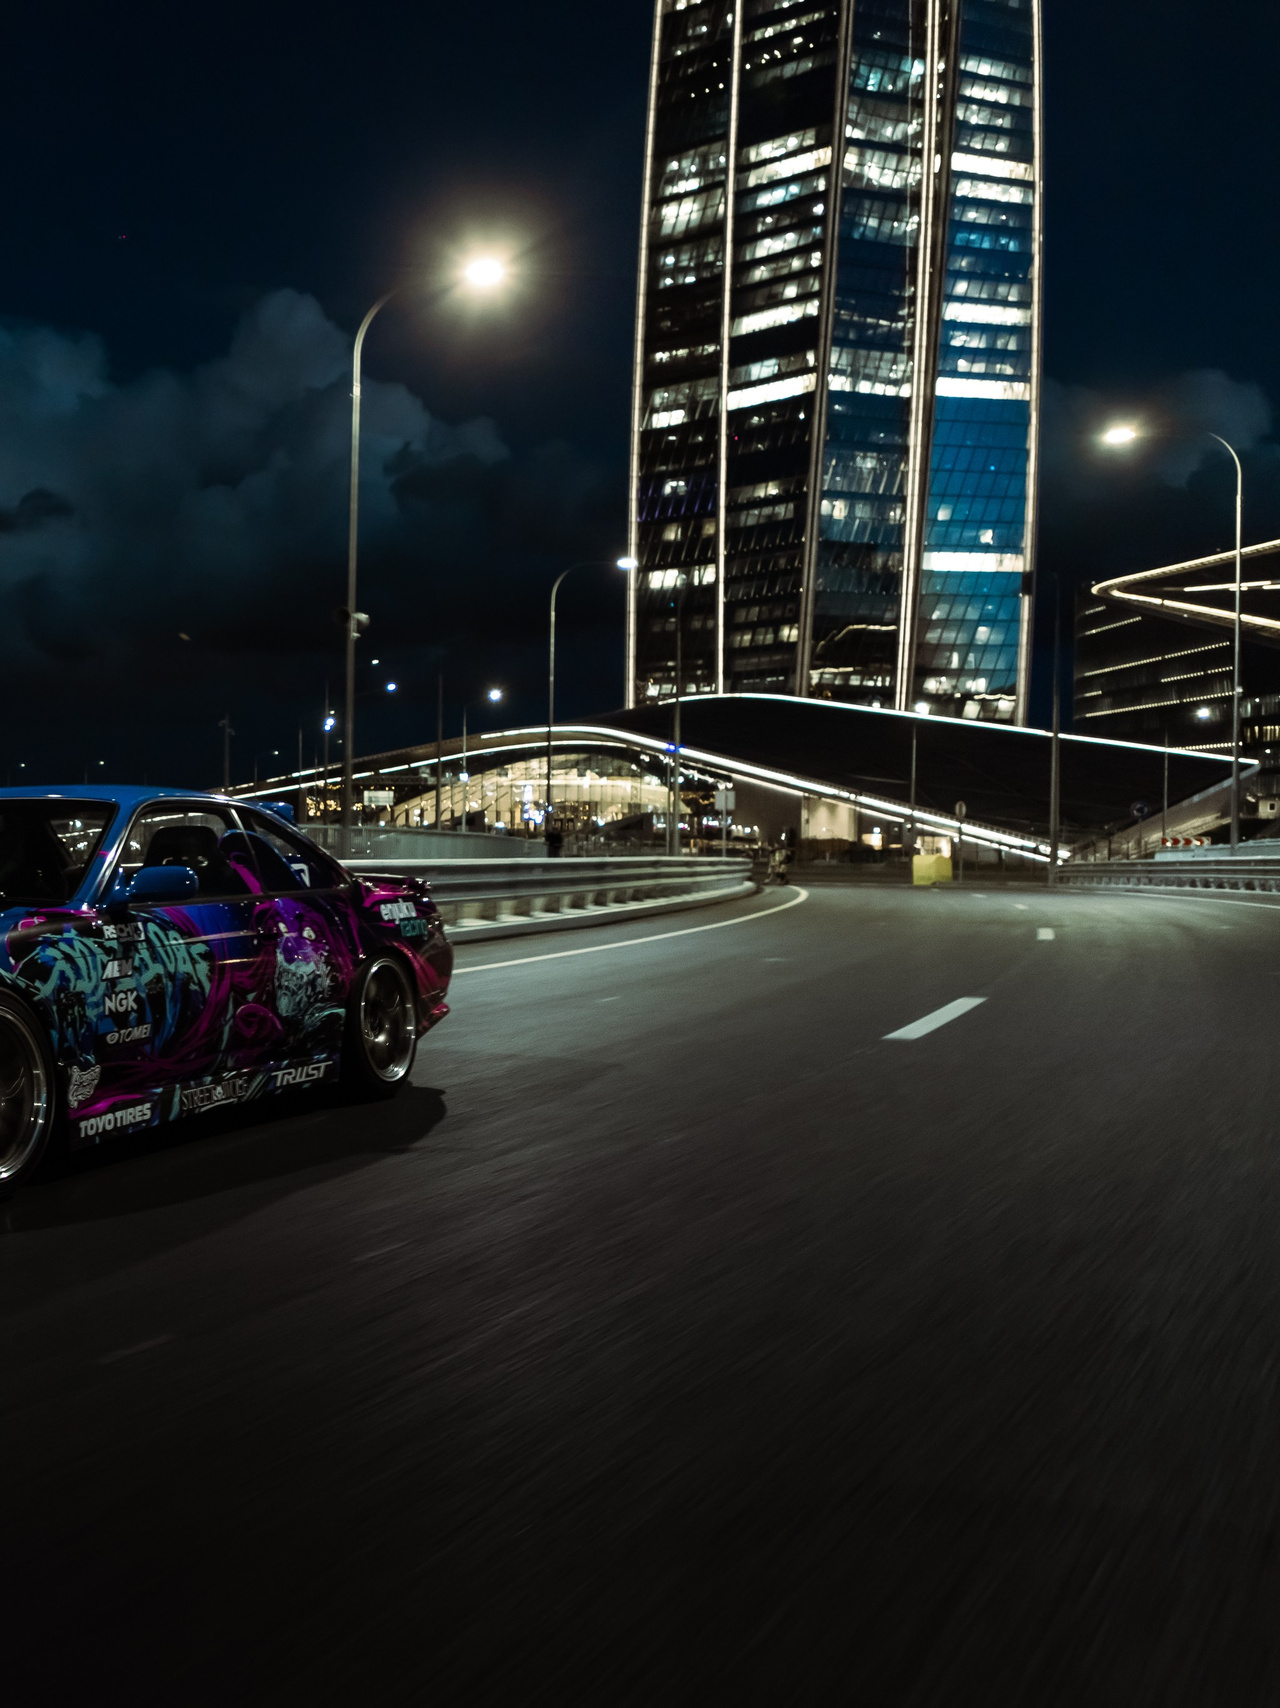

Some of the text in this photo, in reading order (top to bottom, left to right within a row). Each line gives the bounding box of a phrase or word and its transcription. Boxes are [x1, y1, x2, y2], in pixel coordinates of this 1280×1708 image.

[104, 990, 138, 1016] NGK
[271, 1060, 334, 1088] TRUST
[79, 1102, 155, 1138] TOYO TIRES
